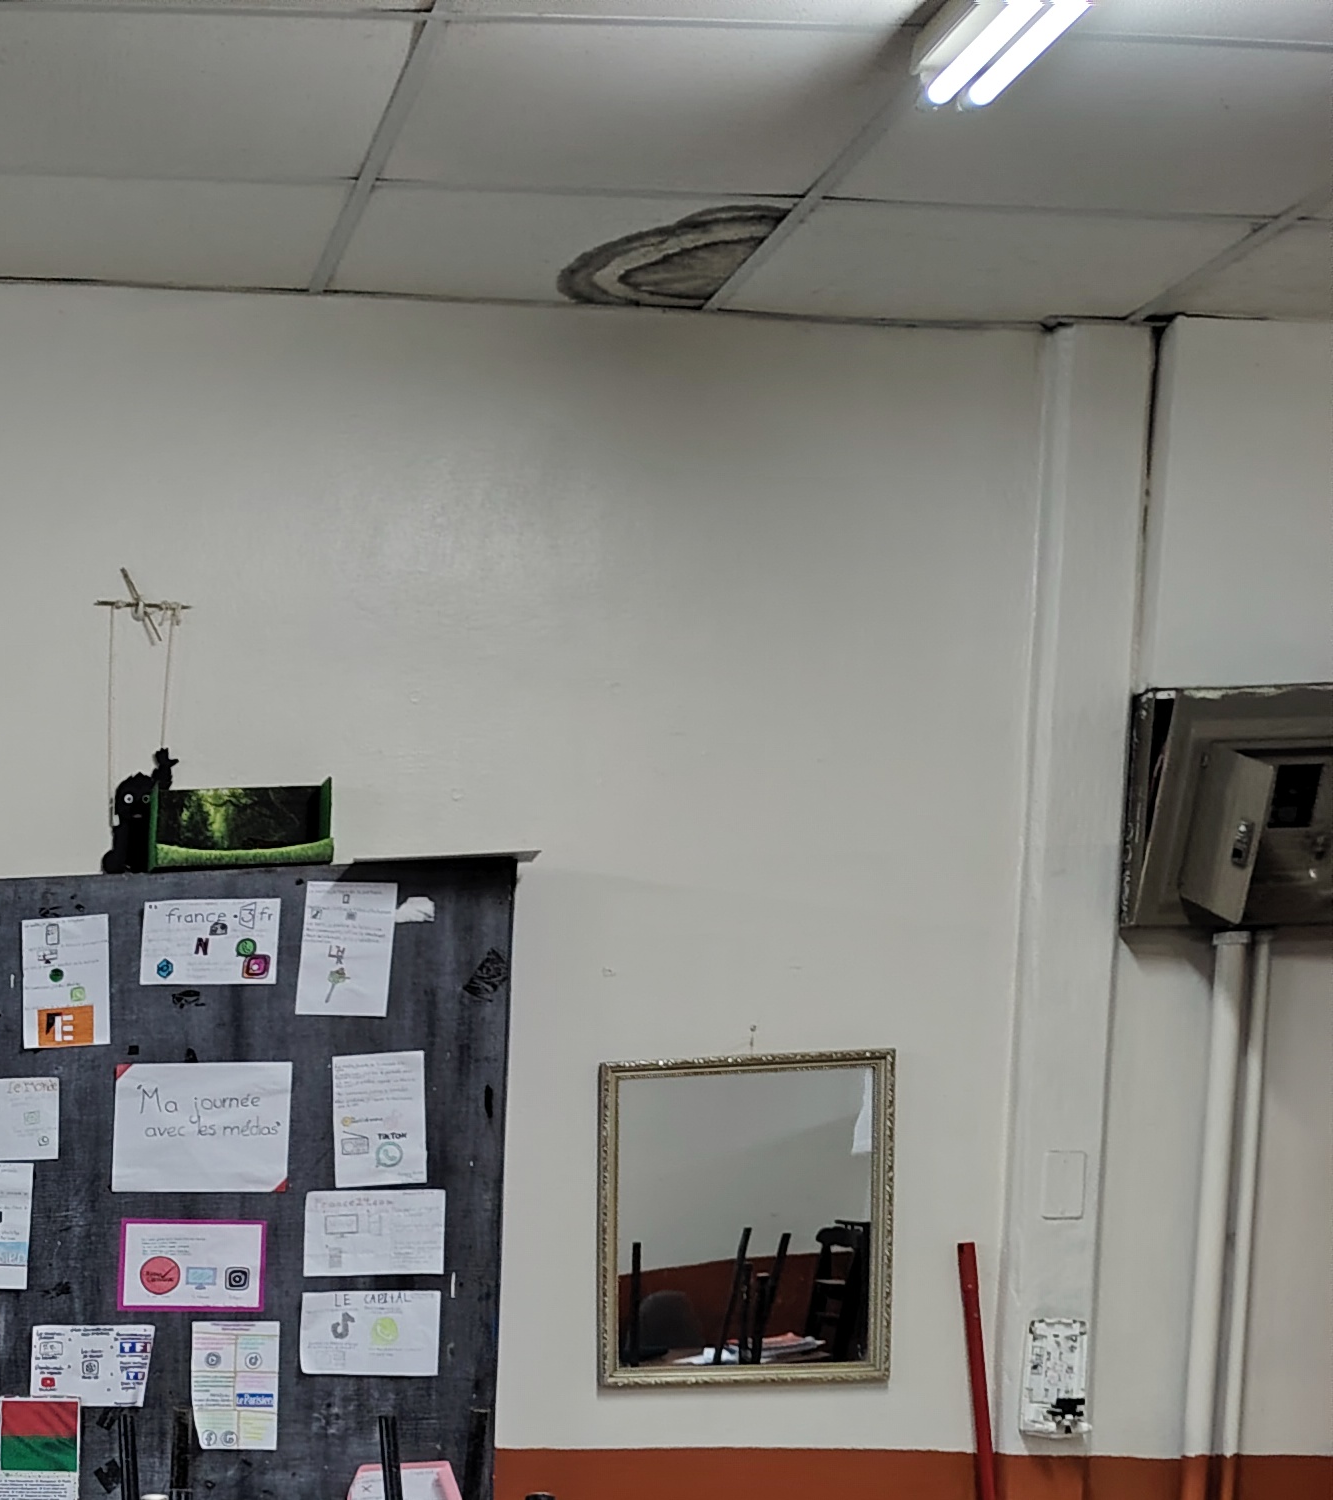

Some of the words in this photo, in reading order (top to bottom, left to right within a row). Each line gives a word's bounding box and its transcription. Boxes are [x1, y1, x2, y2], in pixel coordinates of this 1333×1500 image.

[166, 907, 227, 924] france
[189, 1093, 261, 1124] journée
[145, 1126, 186, 1138] avec
[197, 1116, 217, 1136] les
[334, 1293, 351, 1307] LE
